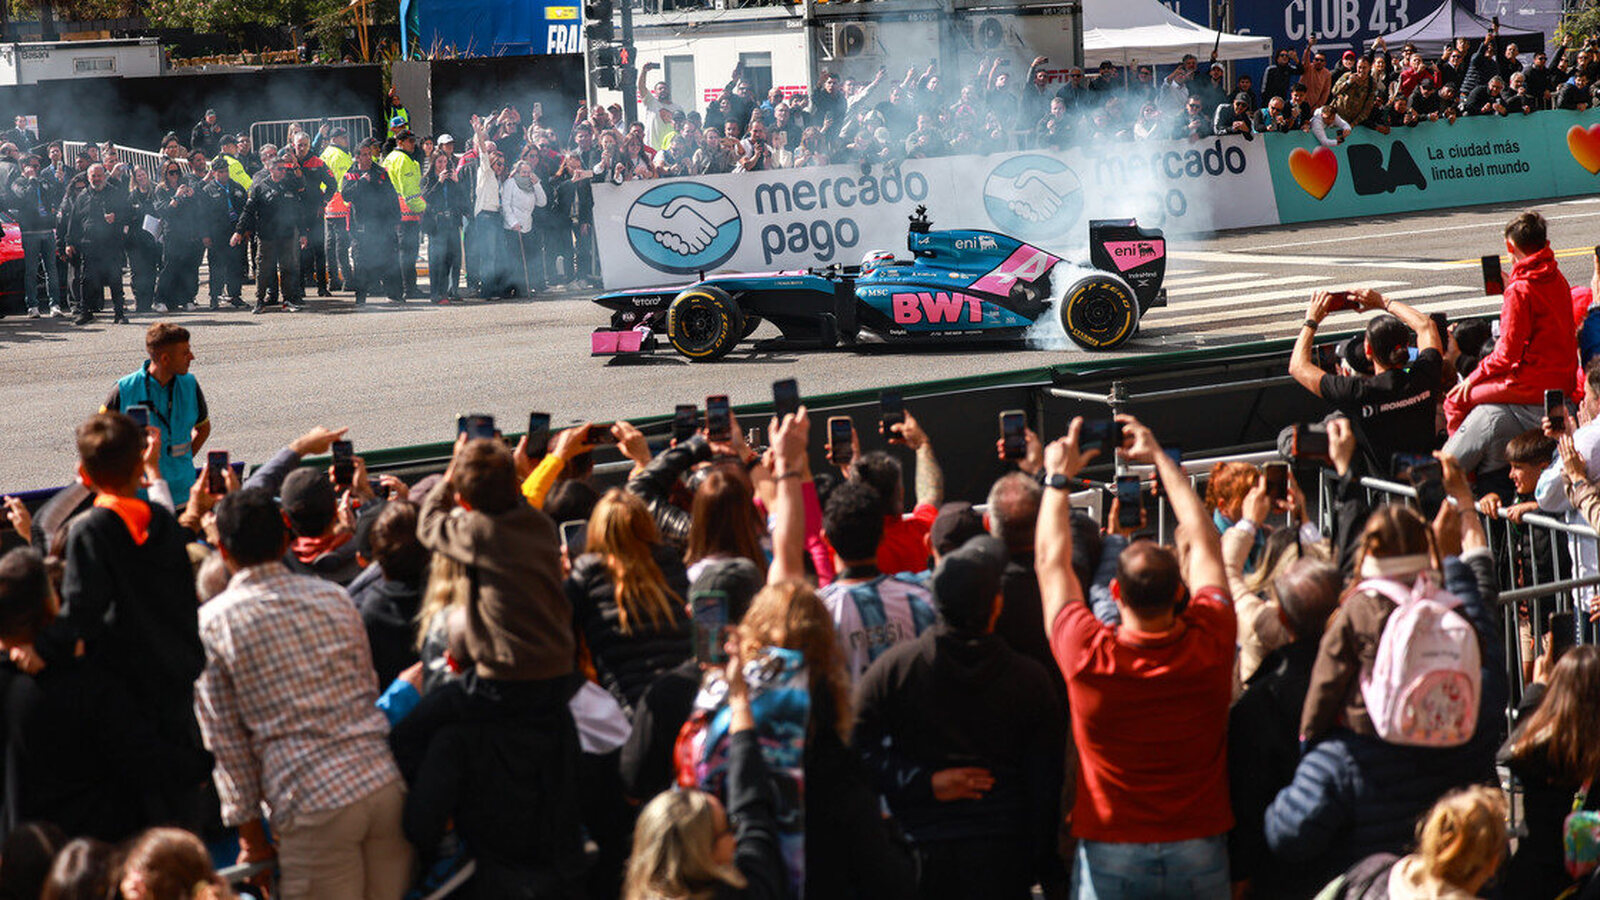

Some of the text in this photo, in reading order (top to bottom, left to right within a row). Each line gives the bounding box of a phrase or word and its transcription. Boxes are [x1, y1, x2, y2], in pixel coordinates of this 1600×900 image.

[1285, 0, 1409, 40] CLUB 43
[1095, 139, 1246, 186] mercado
[1427, 139, 1521, 161] La ciudad más
[1347, 139, 1428, 196] BA
[1431, 159, 1531, 181] linda del mundo
[755, 162, 929, 215] mercado
[761, 217, 860, 265] pago
[954, 236, 977, 249] eni
[1114, 243, 1136, 257] eni
[868, 288, 889, 297] MSC
[892, 292, 984, 324] BWT
